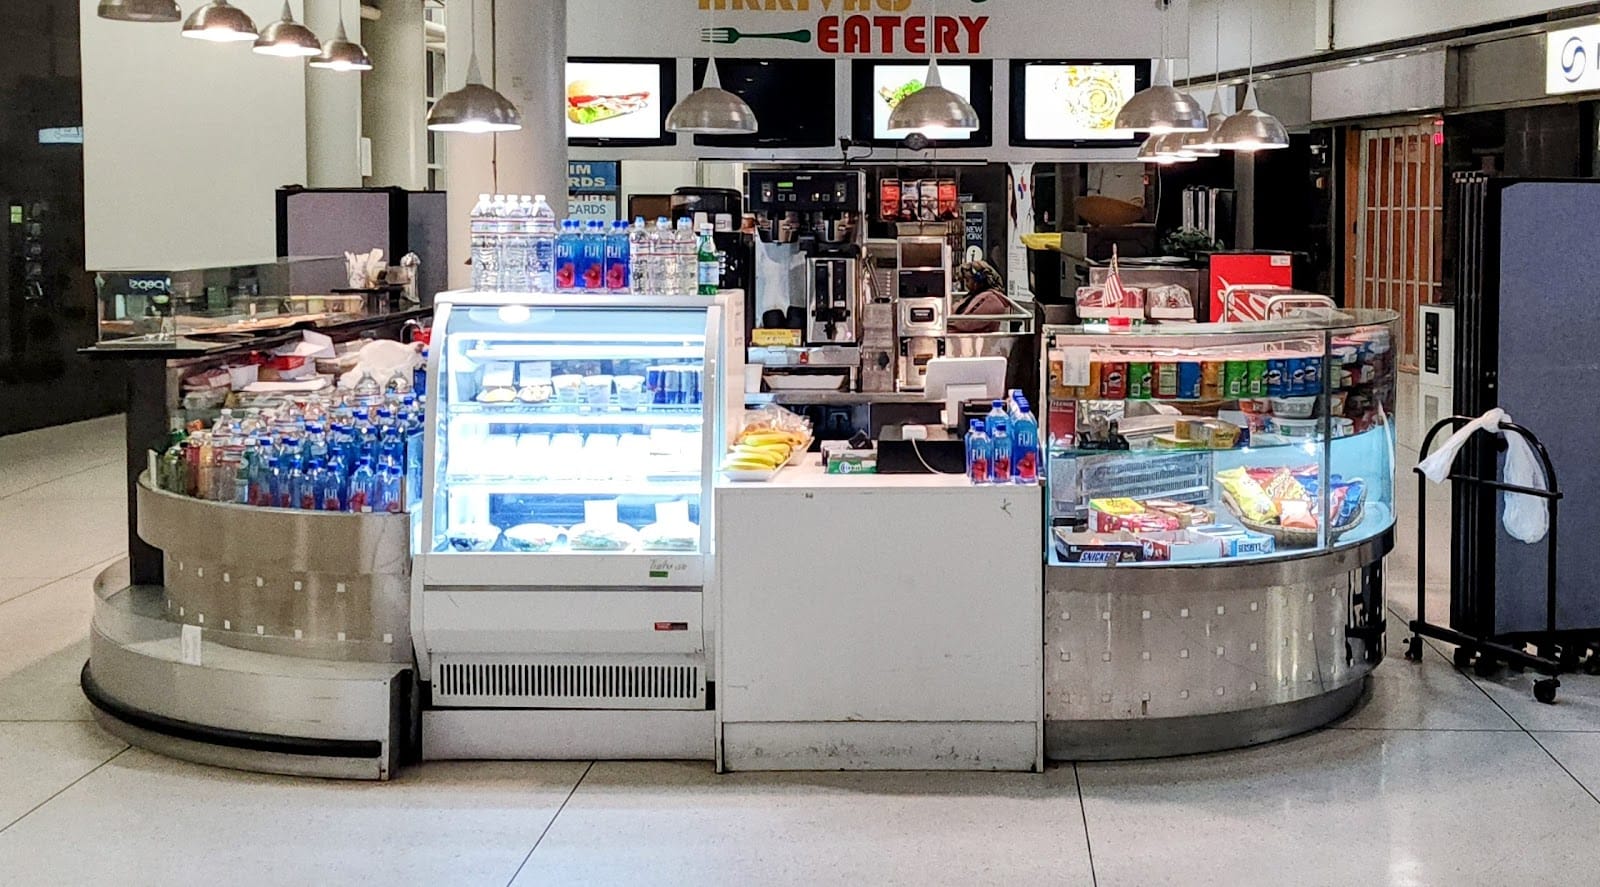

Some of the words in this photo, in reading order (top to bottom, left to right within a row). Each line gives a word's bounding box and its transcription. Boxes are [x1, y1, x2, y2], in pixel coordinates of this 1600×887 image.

[817, 15, 989, 53] EATERY
[569, 164, 591, 175] IM
[569, 177, 606, 187] RDS
[557, 245, 573, 258] FIJI
[584, 245, 600, 258] FIJI
[606, 245, 621, 258] FIJI
[1018, 431, 1033, 446] FIJI
